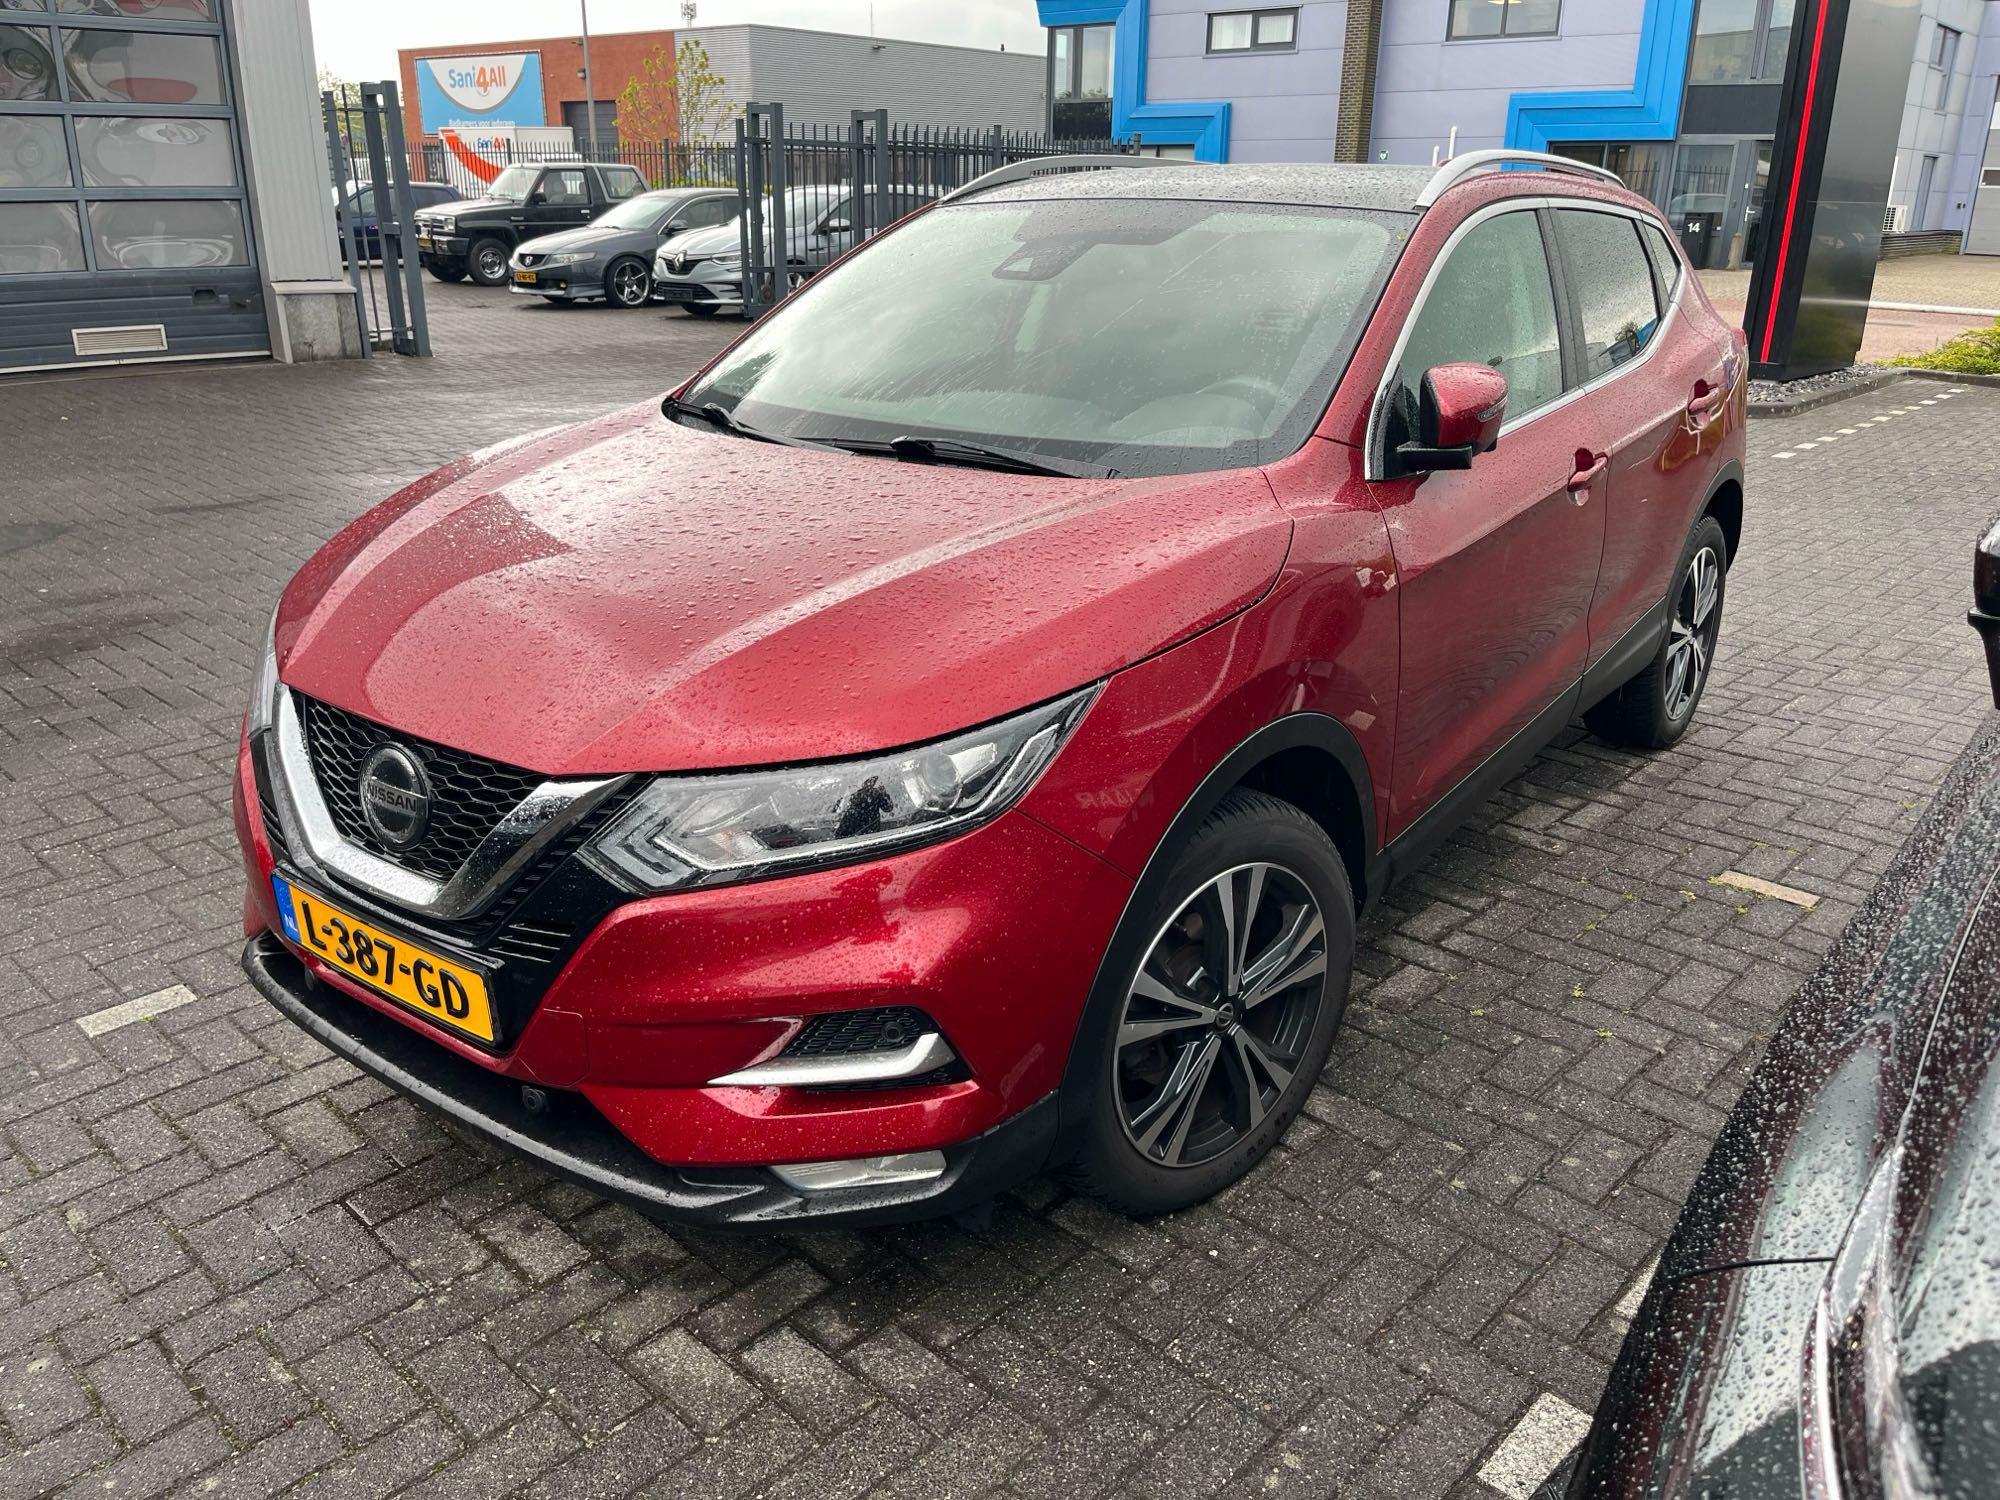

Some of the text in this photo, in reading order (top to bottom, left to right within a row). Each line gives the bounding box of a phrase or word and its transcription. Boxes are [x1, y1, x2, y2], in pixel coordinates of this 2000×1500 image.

[449, 65, 506, 93] Sani4All
[1687, 222, 1700, 233] 14
[365, 783, 417, 812] NISSAN
[283, 912, 298, 934] NL
[301, 900, 470, 1019] L-387-GD
